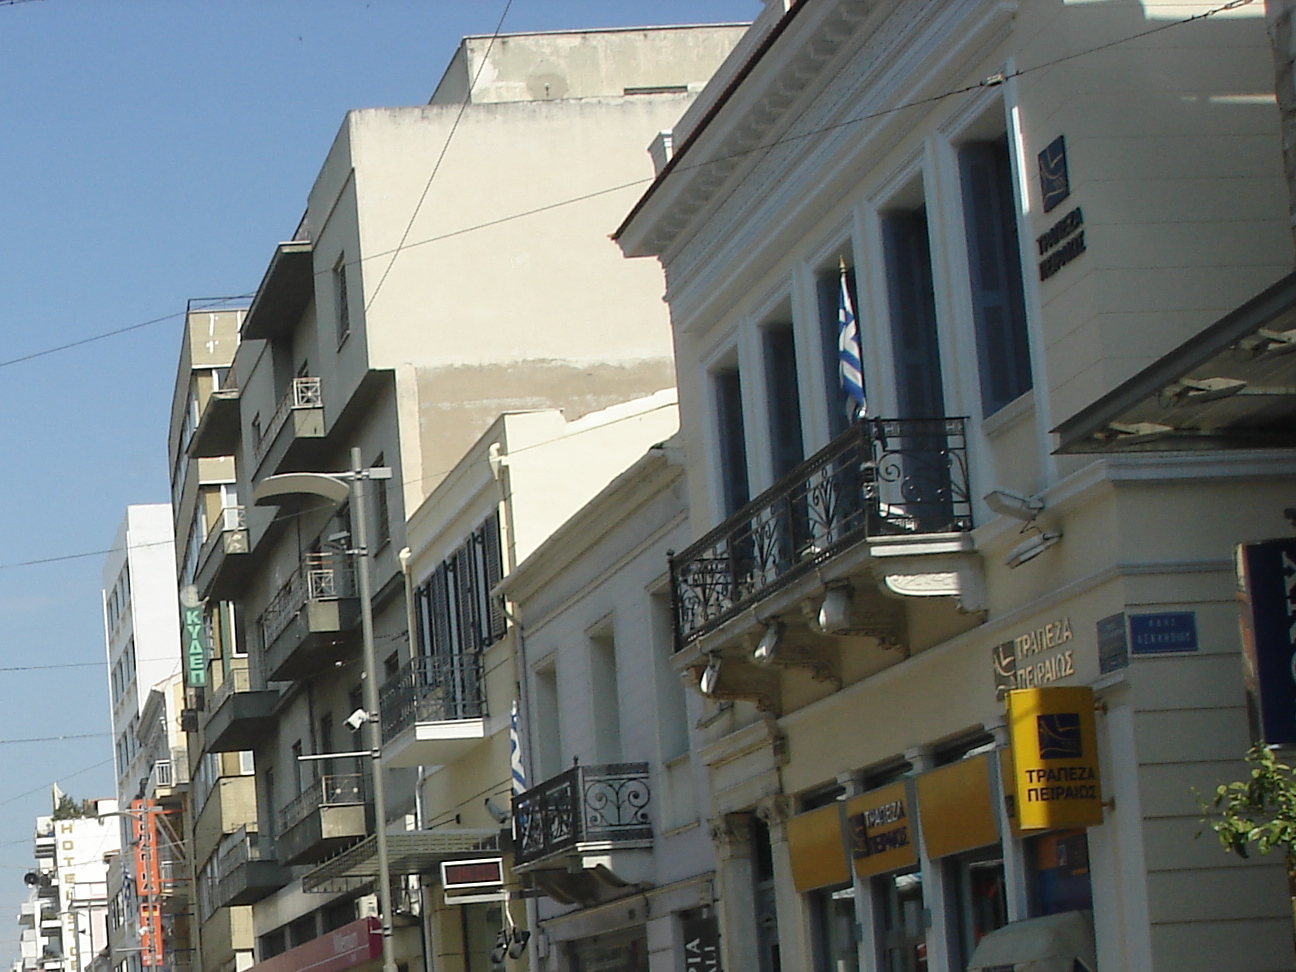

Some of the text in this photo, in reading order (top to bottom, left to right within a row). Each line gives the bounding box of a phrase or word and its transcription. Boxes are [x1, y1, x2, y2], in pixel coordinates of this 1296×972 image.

[186, 610, 205, 683] ΚΥΔΕΠ
[1014, 616, 1073, 661] ΤΡΑΠΕΖΑ
[1016, 650, 1076, 690] ΠΕΙΡΑΙΩΣ
[1024, 766, 1095, 783] ΤΡΑΠΕΖΑ
[1027, 784, 1097, 802] ΠΕΙΡΑΙΩΣ
